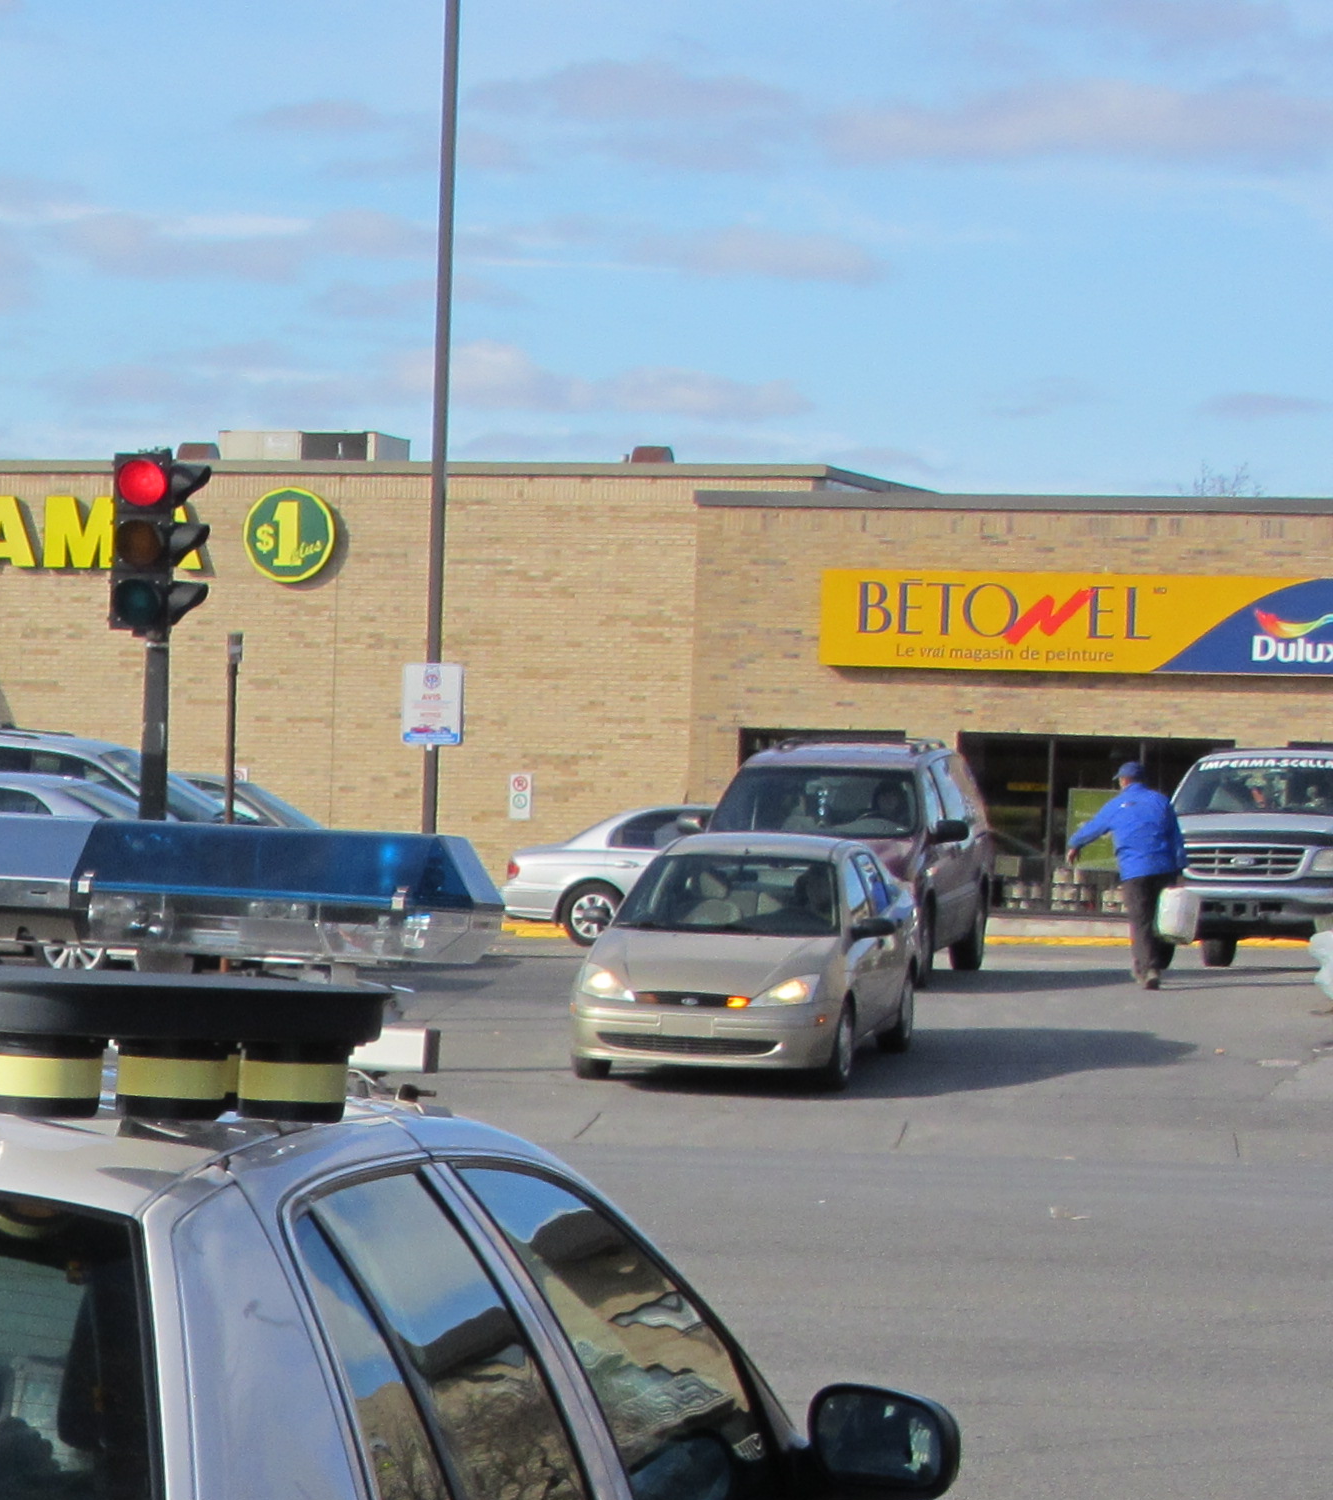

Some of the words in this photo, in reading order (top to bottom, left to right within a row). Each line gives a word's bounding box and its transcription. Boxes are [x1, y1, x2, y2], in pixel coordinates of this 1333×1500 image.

[896, 644, 915, 657] Le
[920, 644, 945, 658] vrai
[949, 647, 1014, 662] magasin
[1020, 646, 1040, 660] de
[1045, 646, 1114, 663] peinture
